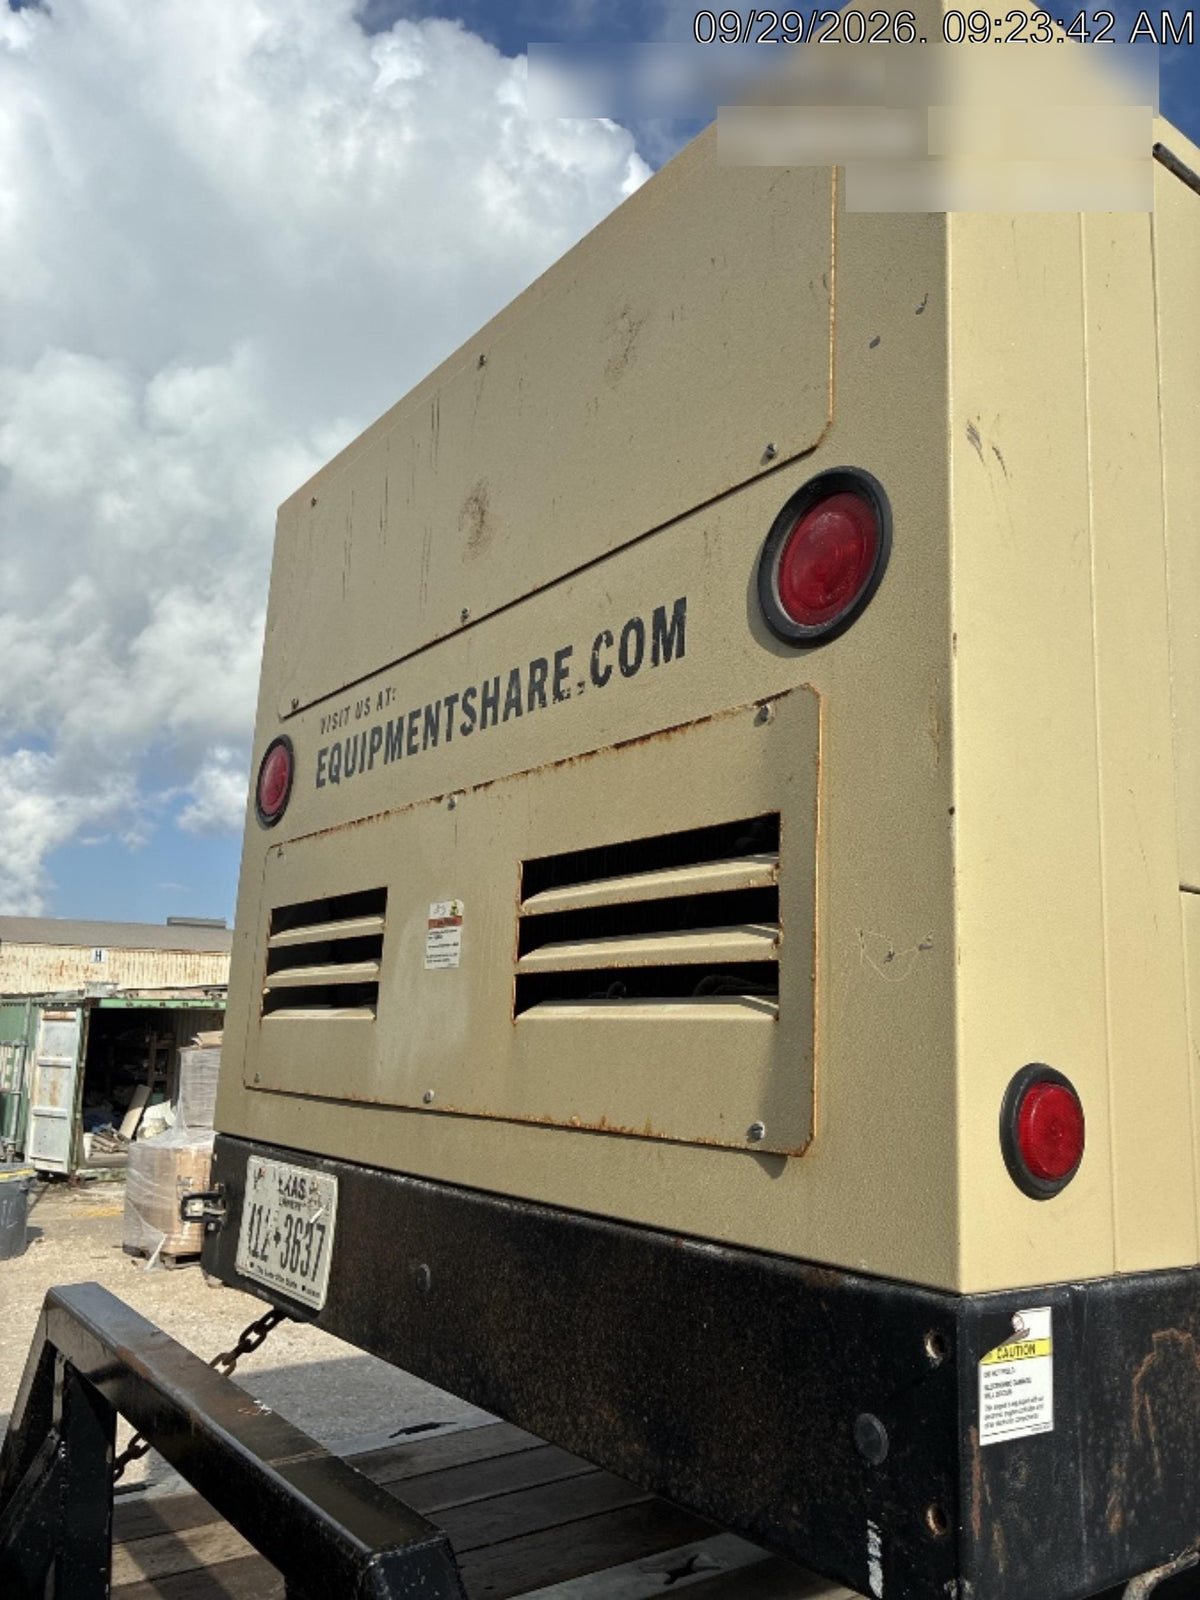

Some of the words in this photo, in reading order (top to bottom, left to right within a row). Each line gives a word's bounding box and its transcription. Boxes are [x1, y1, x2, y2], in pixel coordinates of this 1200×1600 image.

[315, 597, 687, 788] EQUIPMENTSHARE.COM
[321, 705, 351, 735] VISIT
[355, 697, 370, 720] US
[997, 1343, 1036, 1360] CAUTION
